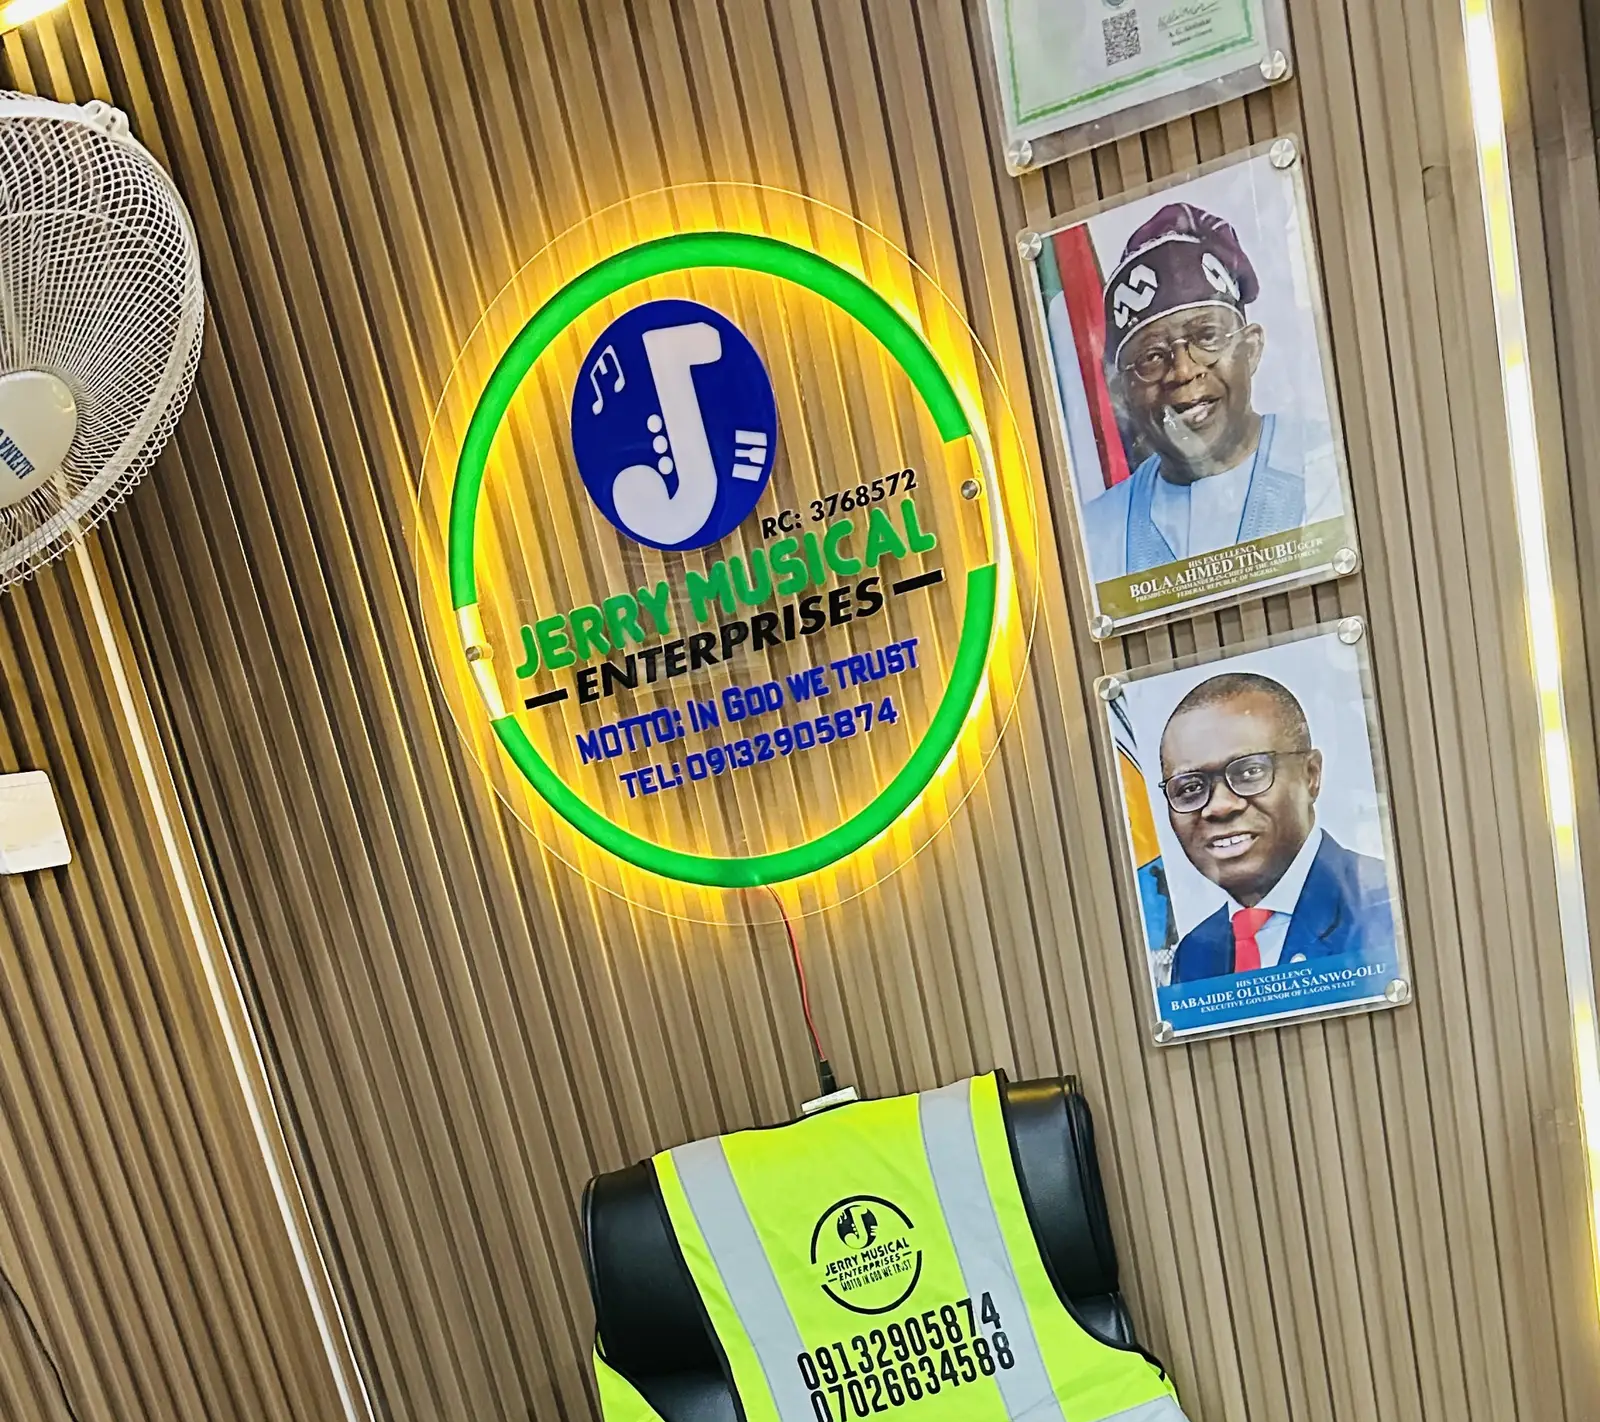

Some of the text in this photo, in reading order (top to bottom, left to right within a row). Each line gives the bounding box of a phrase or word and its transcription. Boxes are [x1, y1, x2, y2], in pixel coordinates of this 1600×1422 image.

[761, 468, 917, 540] RC: 3768572
[1129, 575, 1174, 599] BOLA
[1174, 557, 1234, 587] AHMED
[1235, 540, 1298, 570] TINUBU
[1188, 544, 1257, 569] HIS EXCELLENCY
[515, 498, 936, 680] JERRY MUSICAL
[576, 576, 884, 706] ENTERPRISES
[576, 707, 686, 765] MOTTO:
[786, 665, 830, 703] WE
[831, 637, 920, 691] TRUST
[619, 696, 900, 800] TEL: 09132905874
[1171, 963, 1387, 1011] BABAJIDE OLUSOLA SANWO-OLU
[1200, 979, 1357, 1014] EXECUTIVE GOVERNOR OF LAGOS STATE
[1236, 967, 1313, 989] HIS EXCELLENCY
[825, 1237, 909, 1276] JERRY MUSICAL
[839, 1253, 901, 1282] ENTERPRISES
[892, 1259, 912, 1274] TRUST
[797, 1291, 1001, 1391] 09132905874
